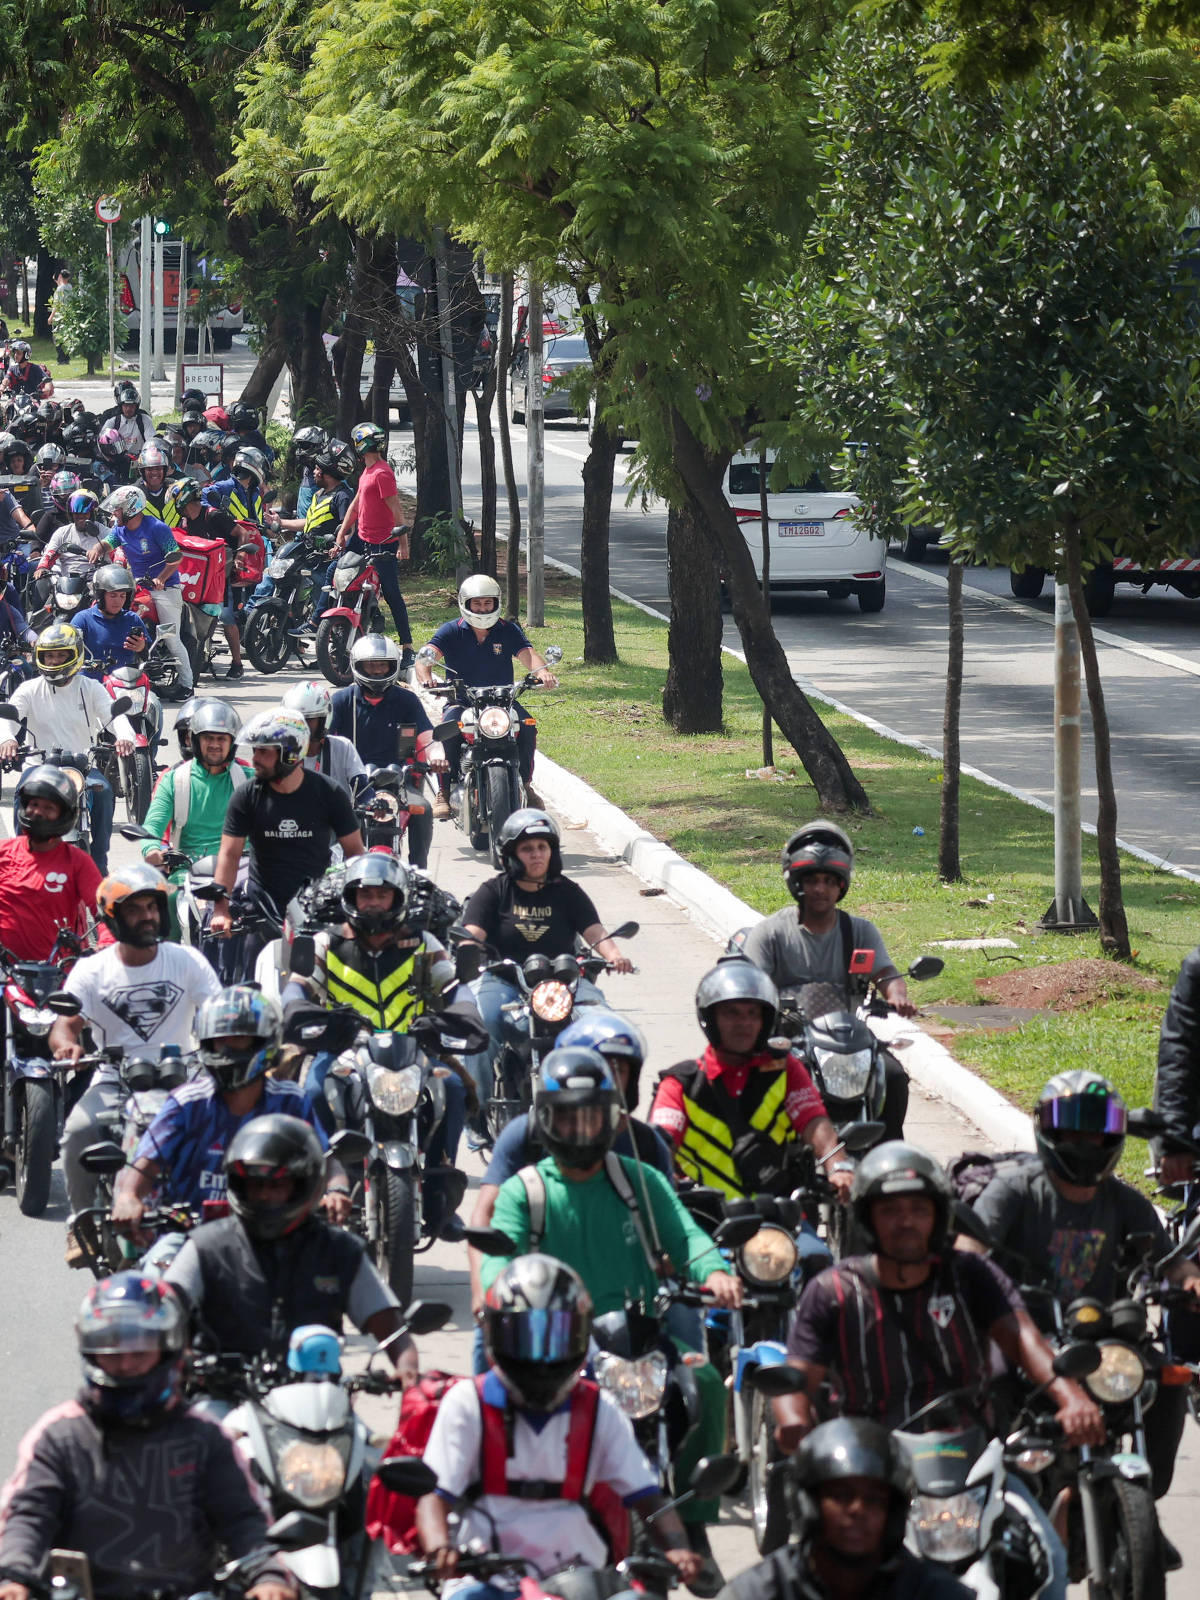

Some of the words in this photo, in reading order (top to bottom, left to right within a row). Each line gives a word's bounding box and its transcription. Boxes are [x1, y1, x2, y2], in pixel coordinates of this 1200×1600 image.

[185, 375, 220, 383] BRETON
[264, 830, 313, 838] BALENCIAGA
[513, 904, 552, 917] MILANO
